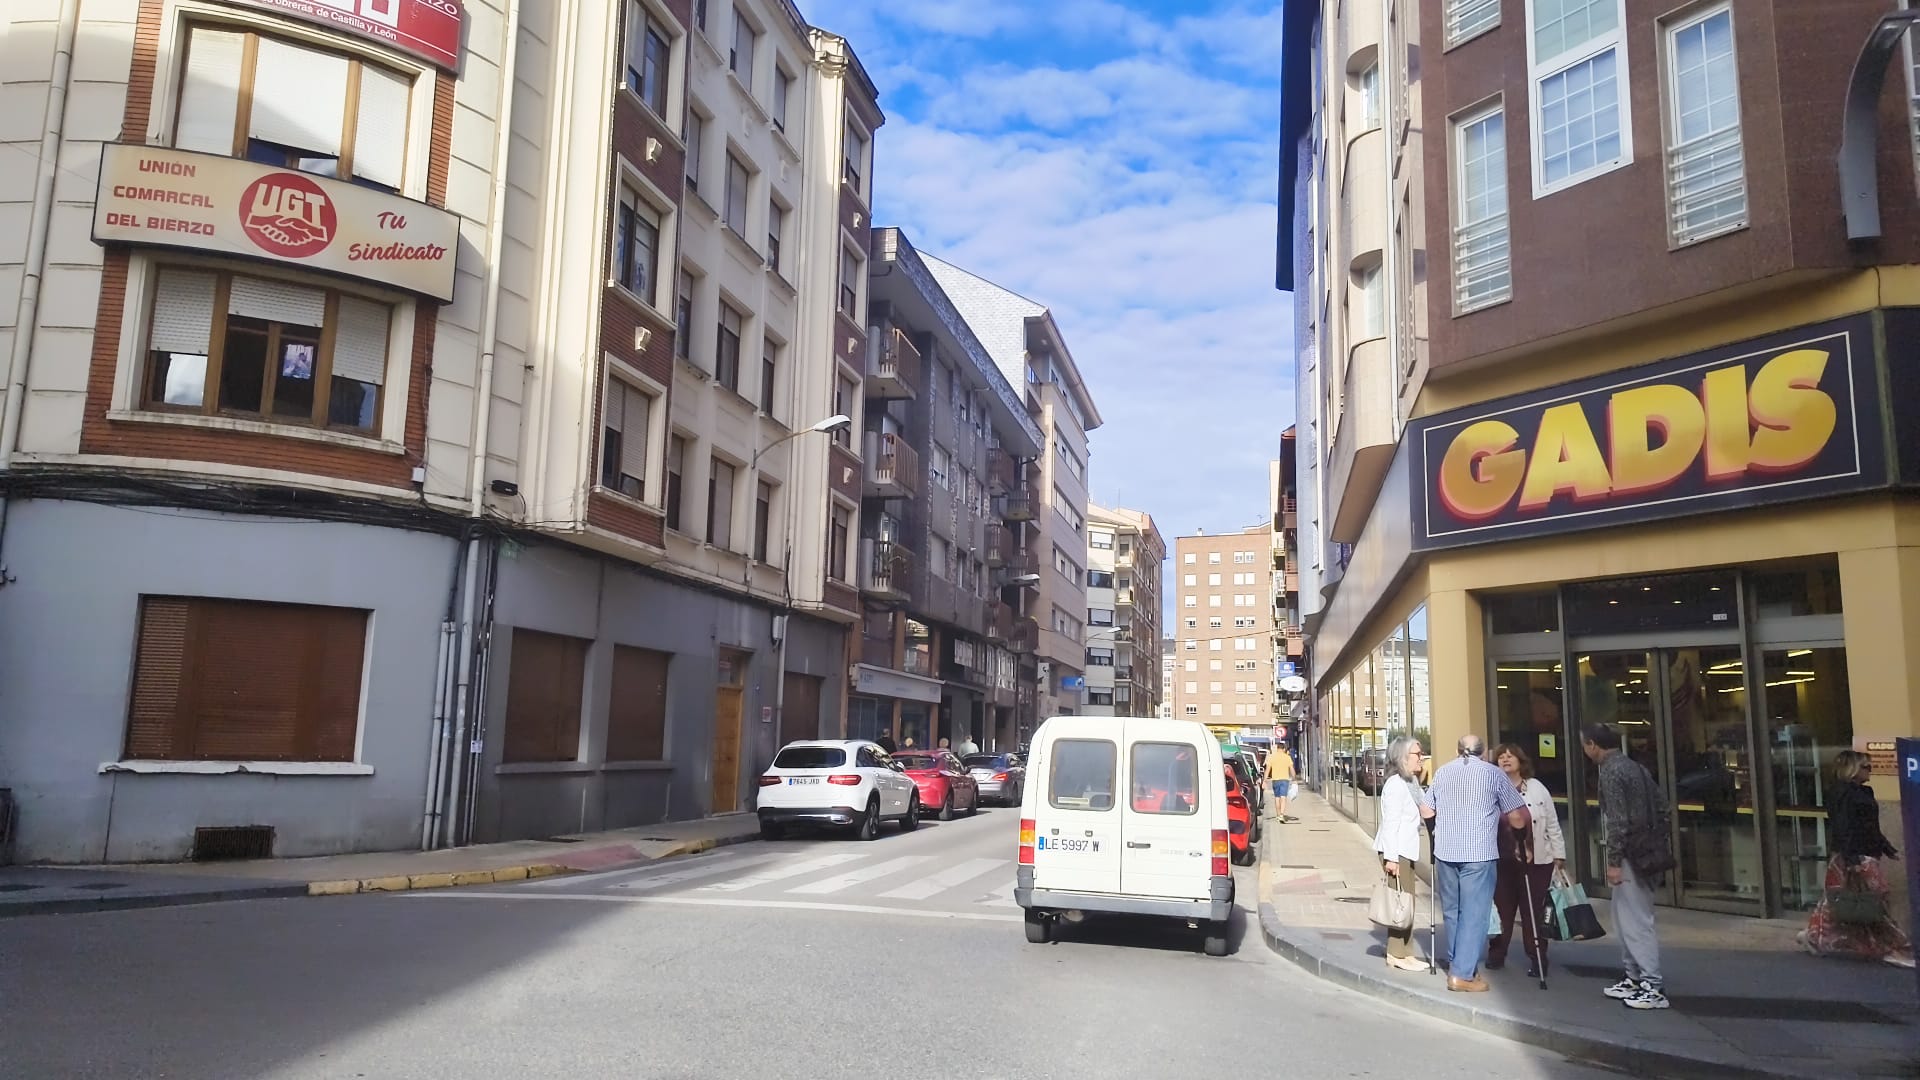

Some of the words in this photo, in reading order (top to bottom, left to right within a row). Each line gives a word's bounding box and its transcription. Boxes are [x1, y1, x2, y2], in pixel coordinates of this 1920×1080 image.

[317, 7, 330, 18] de
[330, 11, 366, 29] Castilla
[365, 24, 374, 33] y
[375, 26, 397, 41] León
[139, 159, 196, 177] UNIÓN
[113, 185, 215, 208] COMARCAL
[251, 183, 327, 228] UGT
[106, 212, 141, 228] DEL
[147, 216, 215, 236] BIERZO
[376, 211, 407, 230] Tu
[348, 241, 448, 262] Sindicato
[1438, 349, 1837, 521] GADIS
[1045, 838, 1059, 850] LE
[1061, 839, 1089, 851] 5997
[1092, 841, 1100, 852] W
